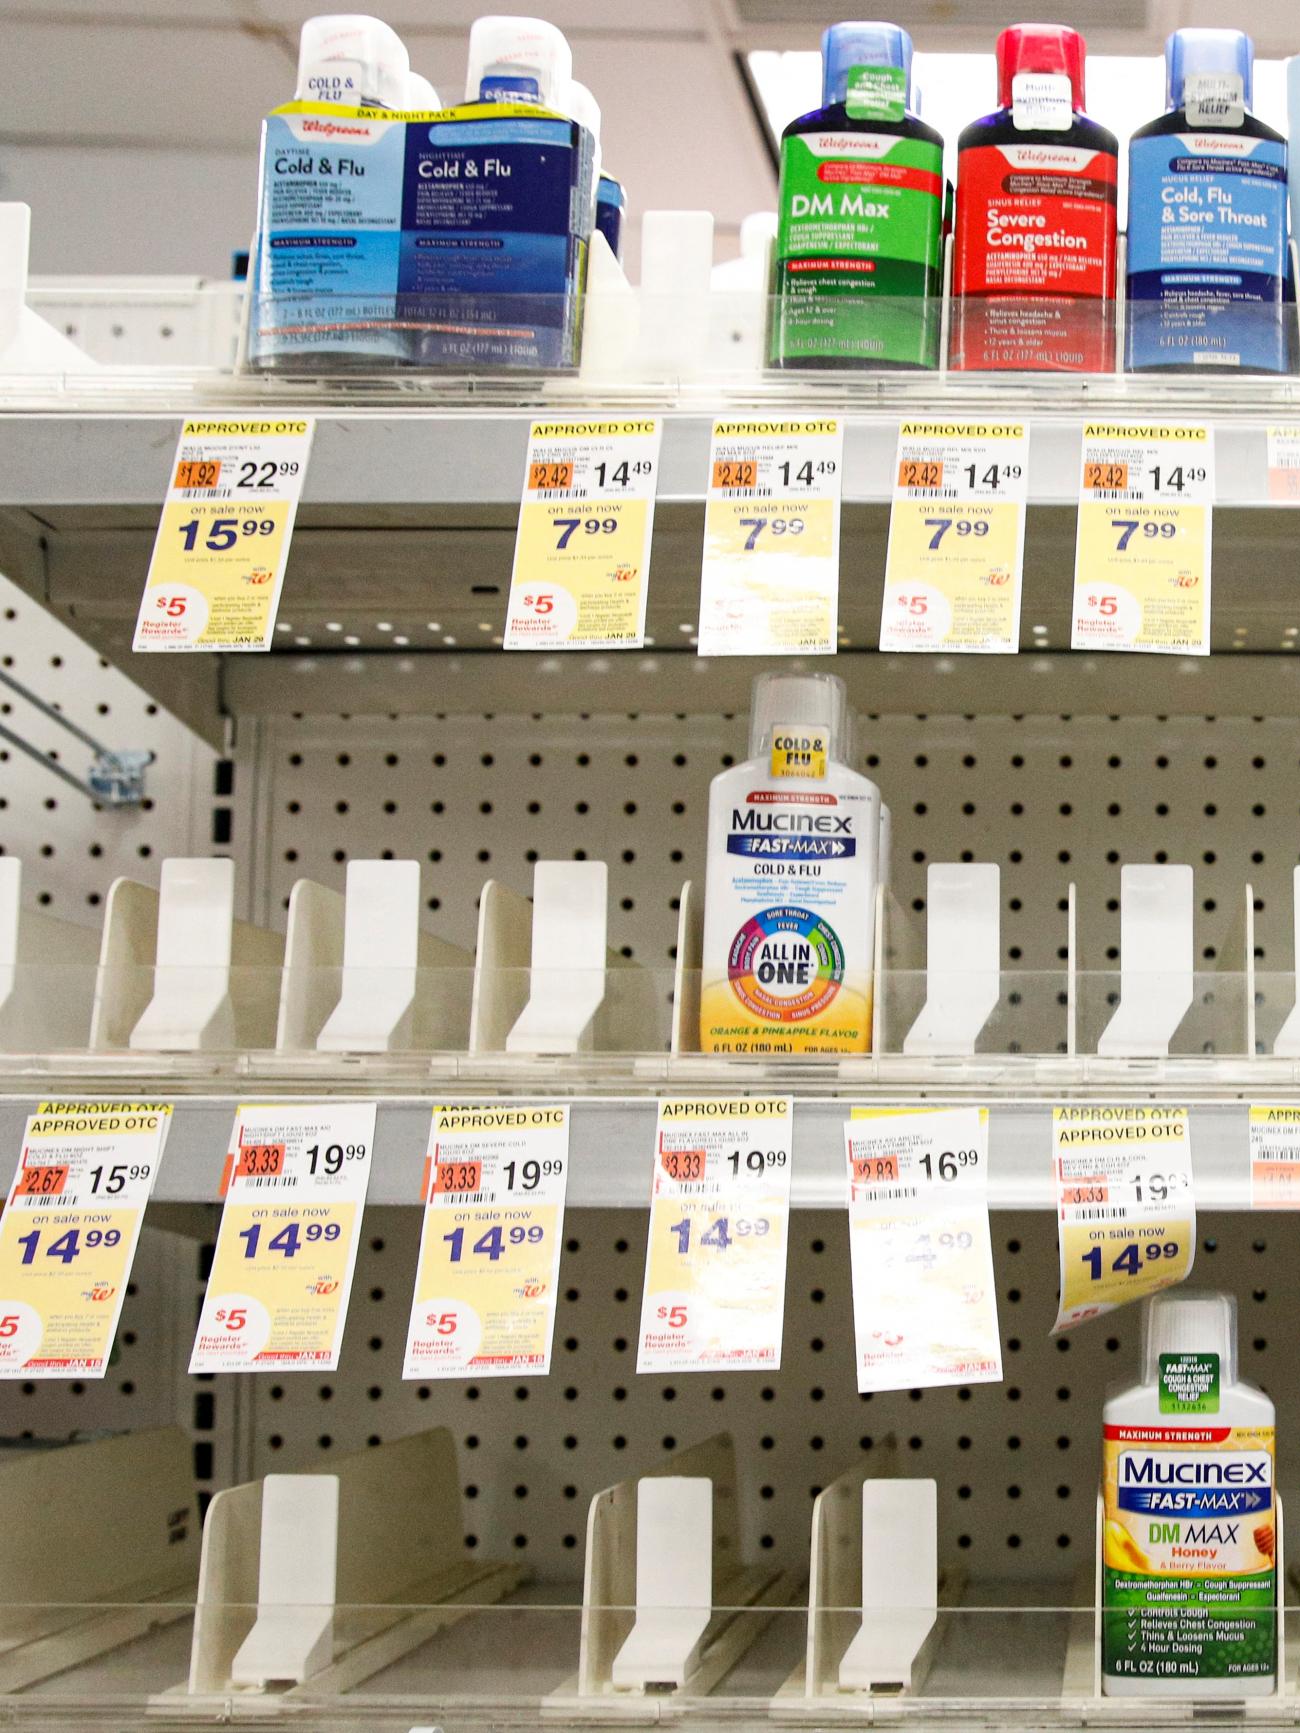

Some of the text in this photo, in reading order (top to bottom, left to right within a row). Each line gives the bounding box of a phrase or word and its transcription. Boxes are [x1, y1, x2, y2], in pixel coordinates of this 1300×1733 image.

[302, 119, 370, 137] Walgreens
[274, 157, 365, 177] Cold & Flu
[1017, 151, 1078, 165] Walgreens
[418, 158, 511, 179] Cold & Flu
[1162, 187, 1232, 206] Cold, Flu
[791, 195, 889, 218] DM Max
[987, 211, 1045, 227] Severe
[1162, 207, 1268, 228] & Sore Throat
[986, 230, 1087, 251] Congestion
[185, 422, 307, 433] APPROVED OTC
[715, 422, 837, 434] APPROVED OTC
[718, 465, 753, 486] $2.42
[904, 464, 938, 485] $2.42
[190, 505, 265, 515] on sale now
[157, 598, 187, 616] $5
[1088, 596, 1117, 615] $5
[774, 737, 823, 752] COLD &
[786, 753, 812, 767] FLU
[732, 809, 852, 833] Mucinex
[754, 863, 821, 876] COLD & FLU
[761, 943, 810, 960] ALL IN
[758, 962, 810, 984] ONE
[663, 1101, 787, 1117] APPROVED OTC
[31, 1118, 158, 1132] APPROVED OTC
[244, 1149, 279, 1173] $3.33
[440, 1166, 476, 1190] $3.33
[1089, 1226, 1165, 1240] on sale now
[215, 1309, 246, 1330] $5
[1119, 1430, 1212, 1441] MAXIMUM STRENGTH
[1124, 1457, 1266, 1484] Mucinex
[1149, 1524, 1239, 1544] DM MAX
[1171, 1547, 1217, 1559] Honey
[1141, 1619, 1256, 1630] Relieves Chest Congestion
[1116, 1661, 1199, 1675] 6 FL OZ (180 mL)
